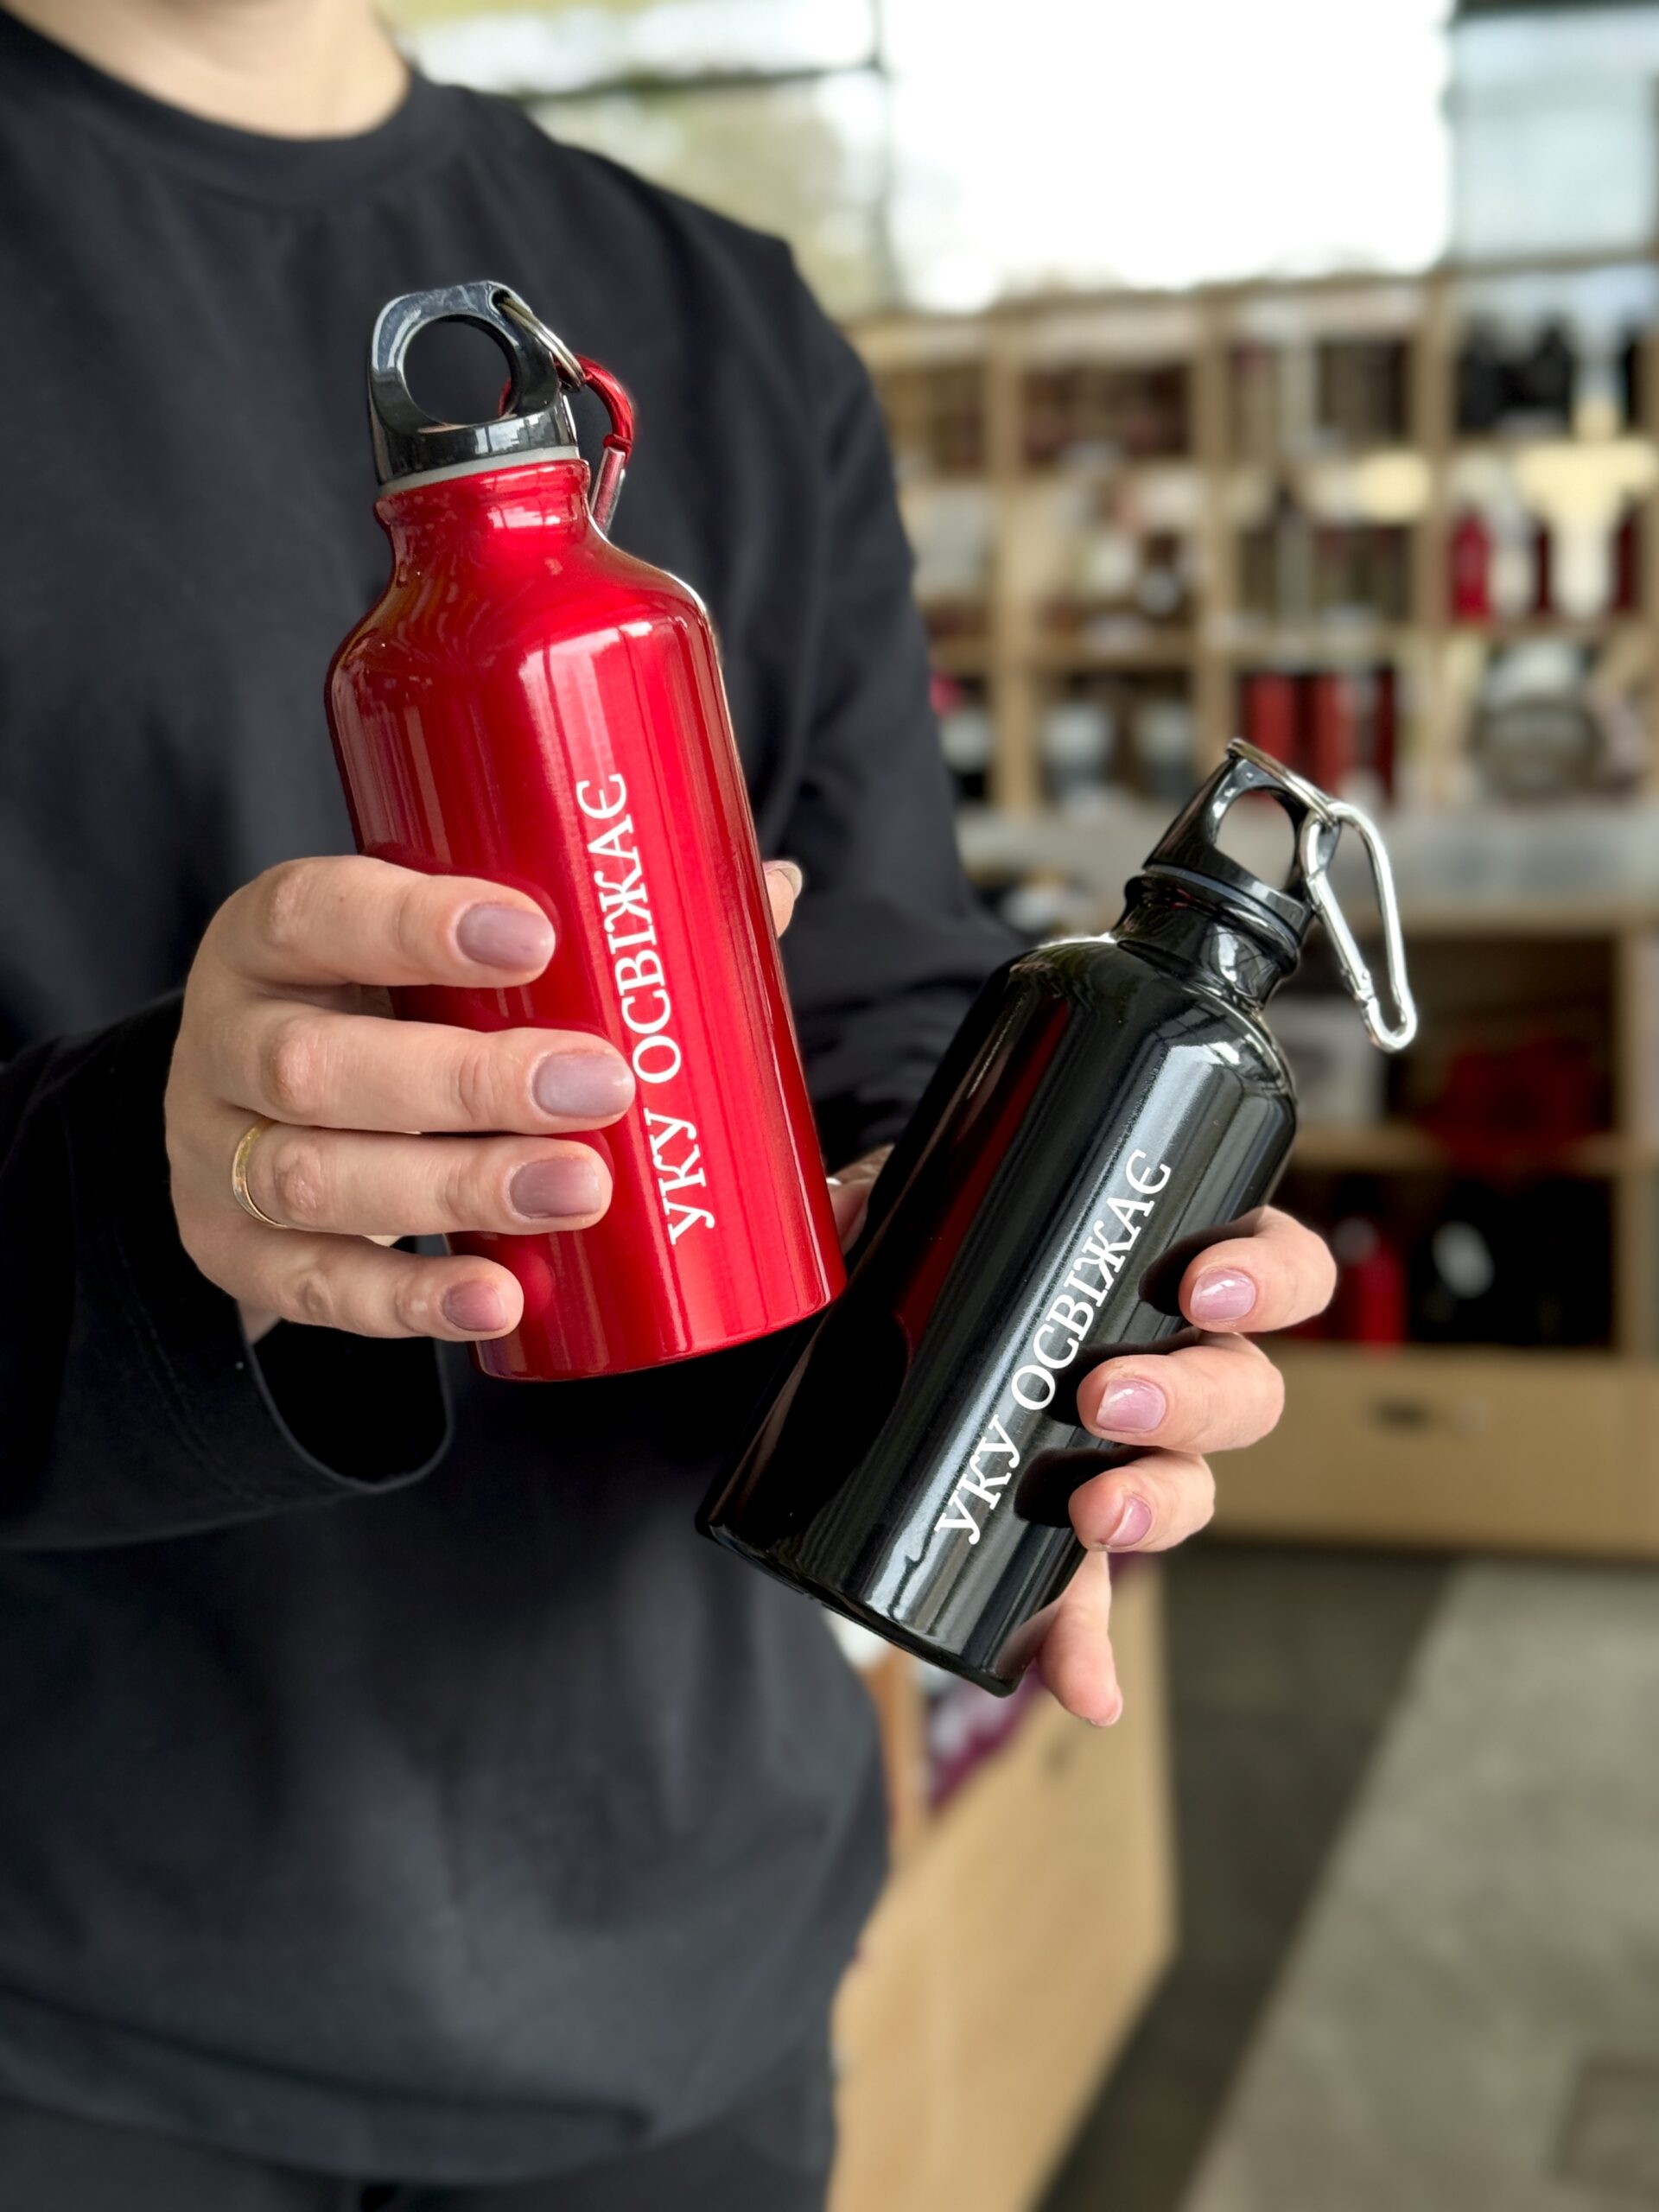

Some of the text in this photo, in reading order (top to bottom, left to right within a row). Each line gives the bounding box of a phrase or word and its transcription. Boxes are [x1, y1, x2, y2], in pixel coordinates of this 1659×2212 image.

[576, 772, 715, 1245] УКУ ОСВІЖАЄ
[934, 1147, 1172, 1545] УКУ ОСВІЖАЄ
